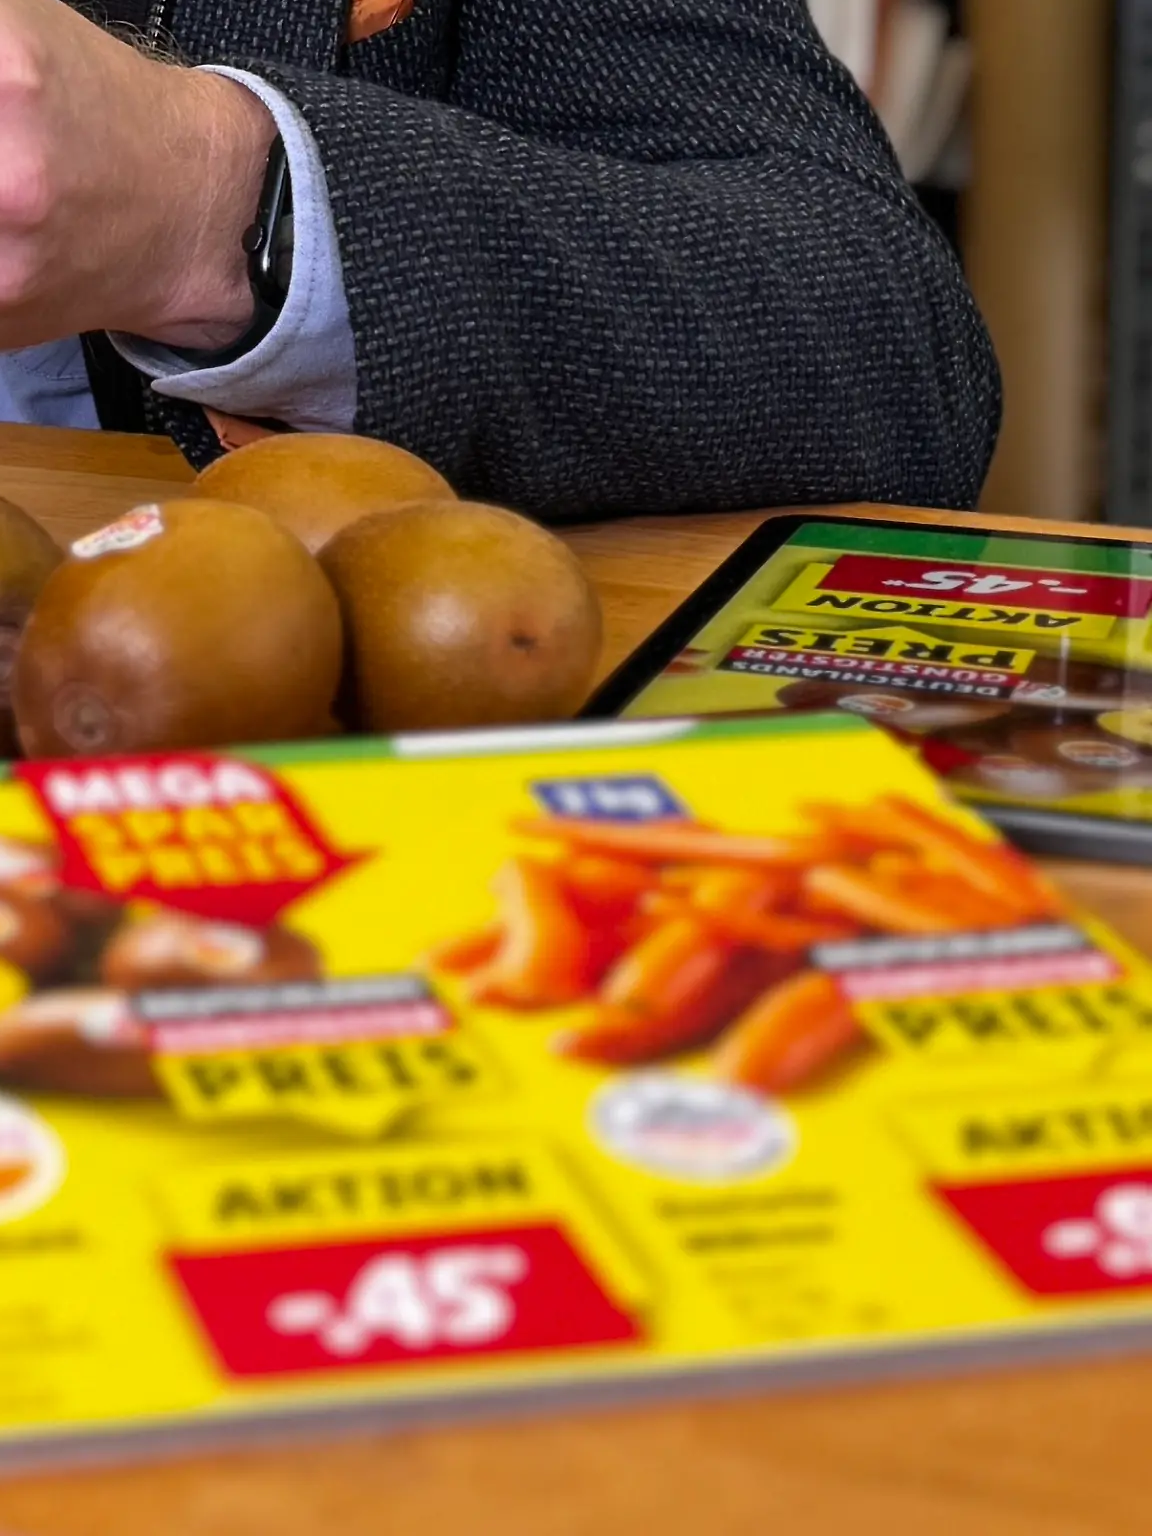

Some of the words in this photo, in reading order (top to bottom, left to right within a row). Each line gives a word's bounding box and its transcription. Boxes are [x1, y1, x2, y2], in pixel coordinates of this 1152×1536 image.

[805, 594, 1082, 628] AKTION
[741, 648, 1010, 683] GÜNSTIGSTER
[755, 626, 1017, 669] PREIS
[729, 659, 1000, 696] DEUTSCHLANDS
[181, 1038, 480, 1102] PREIS
[213, 1162, 532, 1226] AKTION
